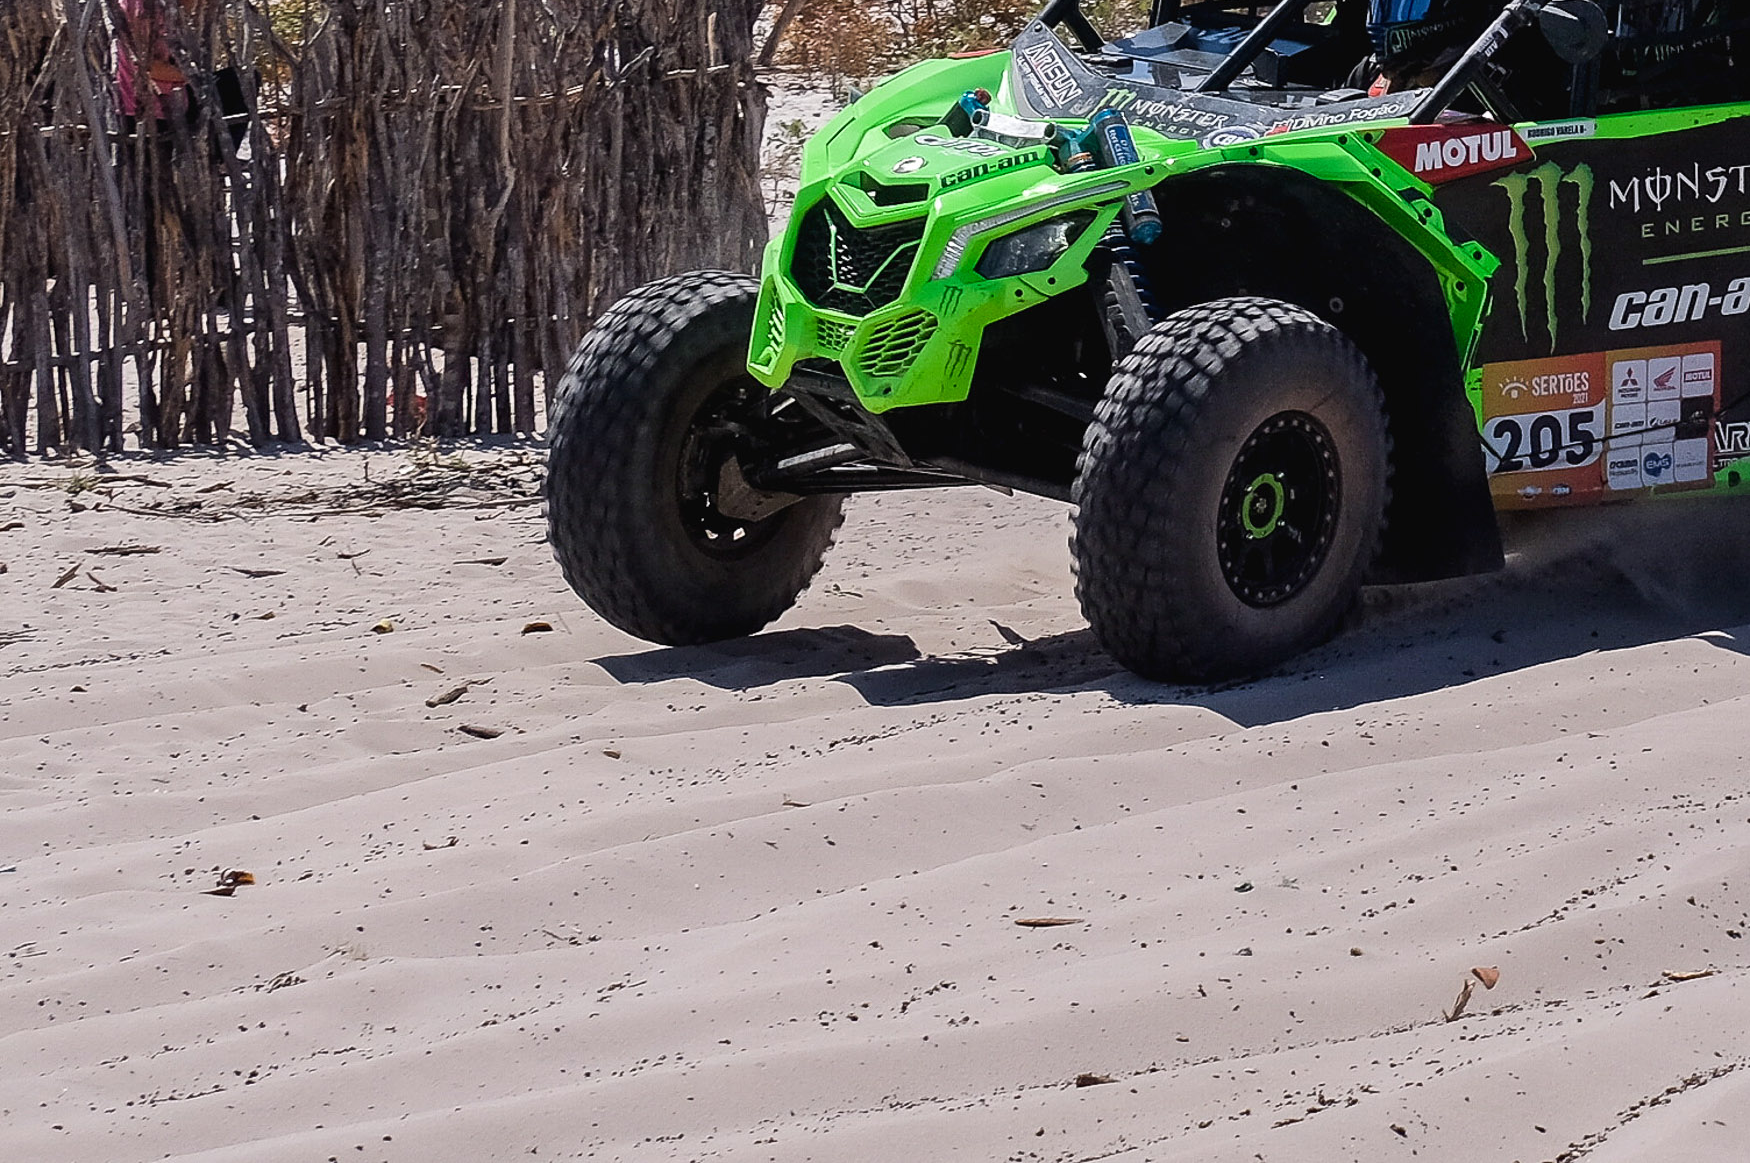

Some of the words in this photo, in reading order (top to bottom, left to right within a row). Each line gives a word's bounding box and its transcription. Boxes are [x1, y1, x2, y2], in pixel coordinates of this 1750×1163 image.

[1021, 40, 1084, 107] ARISUN
[1129, 98, 1230, 130] MONSTER
[1132, 119, 1203, 137] ENERGY
[1292, 112, 1347, 130] Divino
[1348, 102, 1399, 121] Fogão
[941, 151, 1039, 188] can-am
[1414, 130, 1517, 173] MOTUL
[1492, 409, 1595, 474] 205
